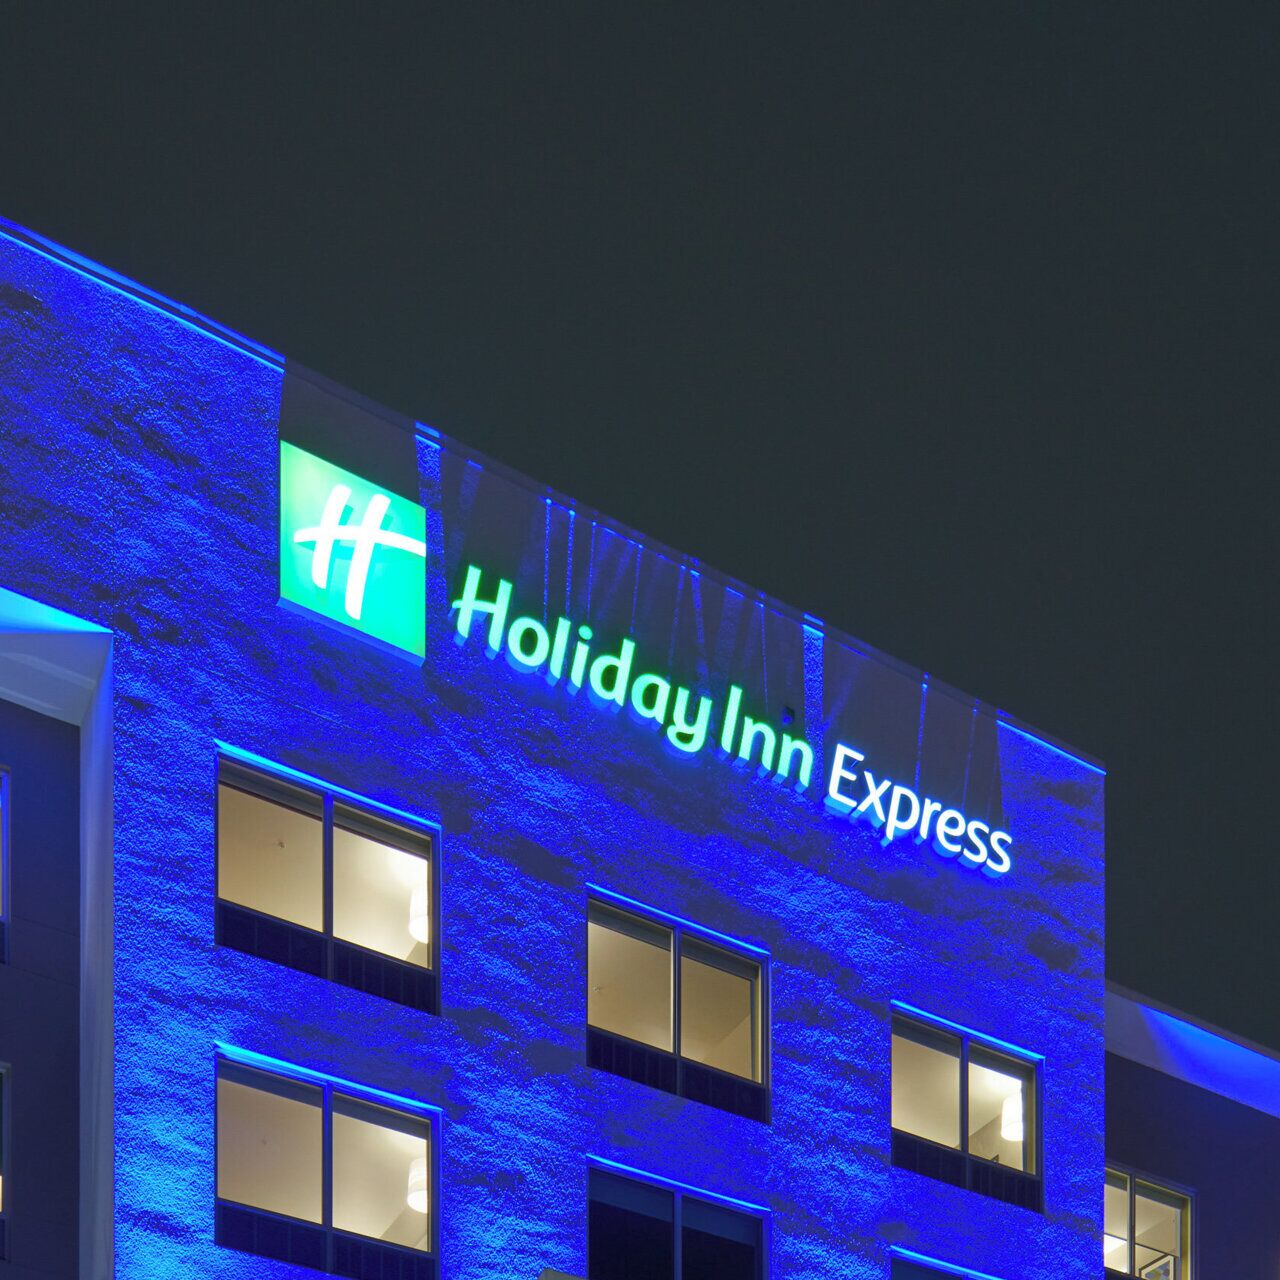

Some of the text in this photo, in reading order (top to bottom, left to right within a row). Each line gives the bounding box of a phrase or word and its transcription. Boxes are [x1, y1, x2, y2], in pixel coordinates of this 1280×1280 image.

[452, 564, 1012, 873] Holiday Inn Express
